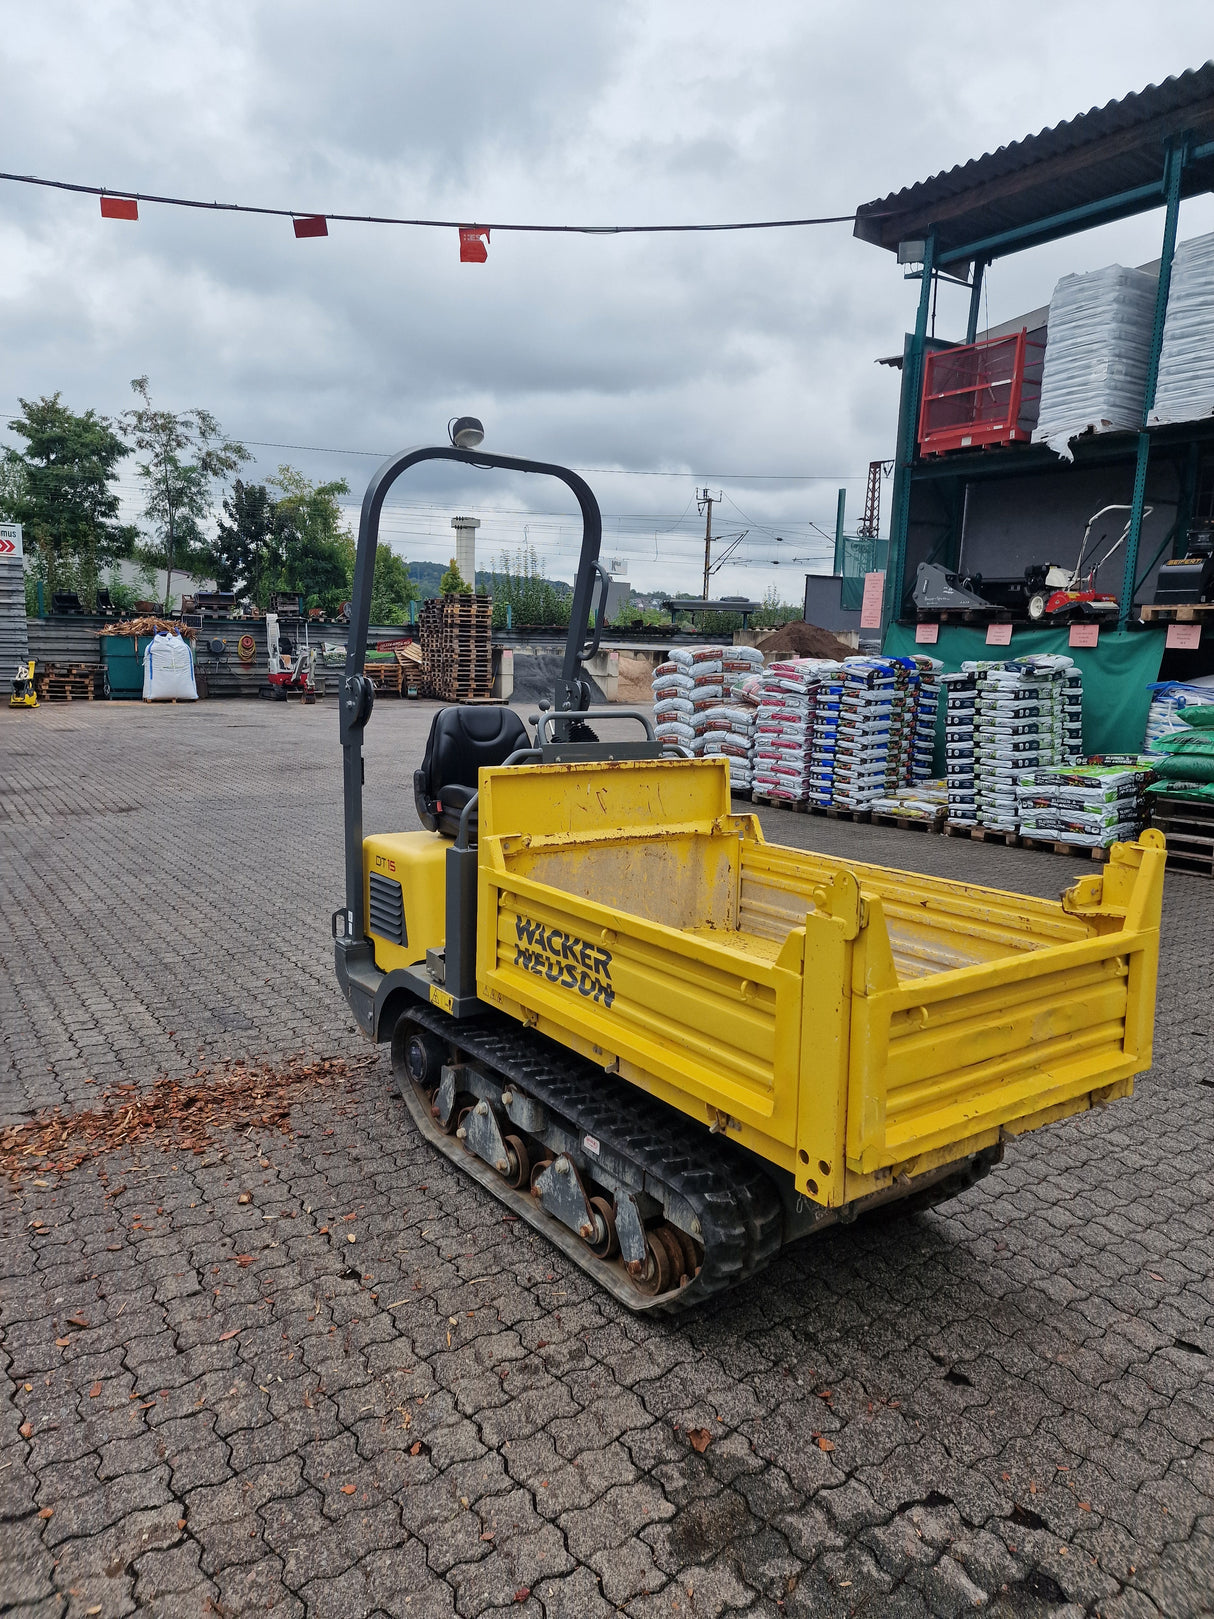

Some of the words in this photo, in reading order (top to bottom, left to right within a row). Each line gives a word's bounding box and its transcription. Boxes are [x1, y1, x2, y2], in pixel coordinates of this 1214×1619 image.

[376, 855, 396, 872] DT15
[514, 943, 616, 1009] NEUSON
[515, 914, 613, 981] WACKER
